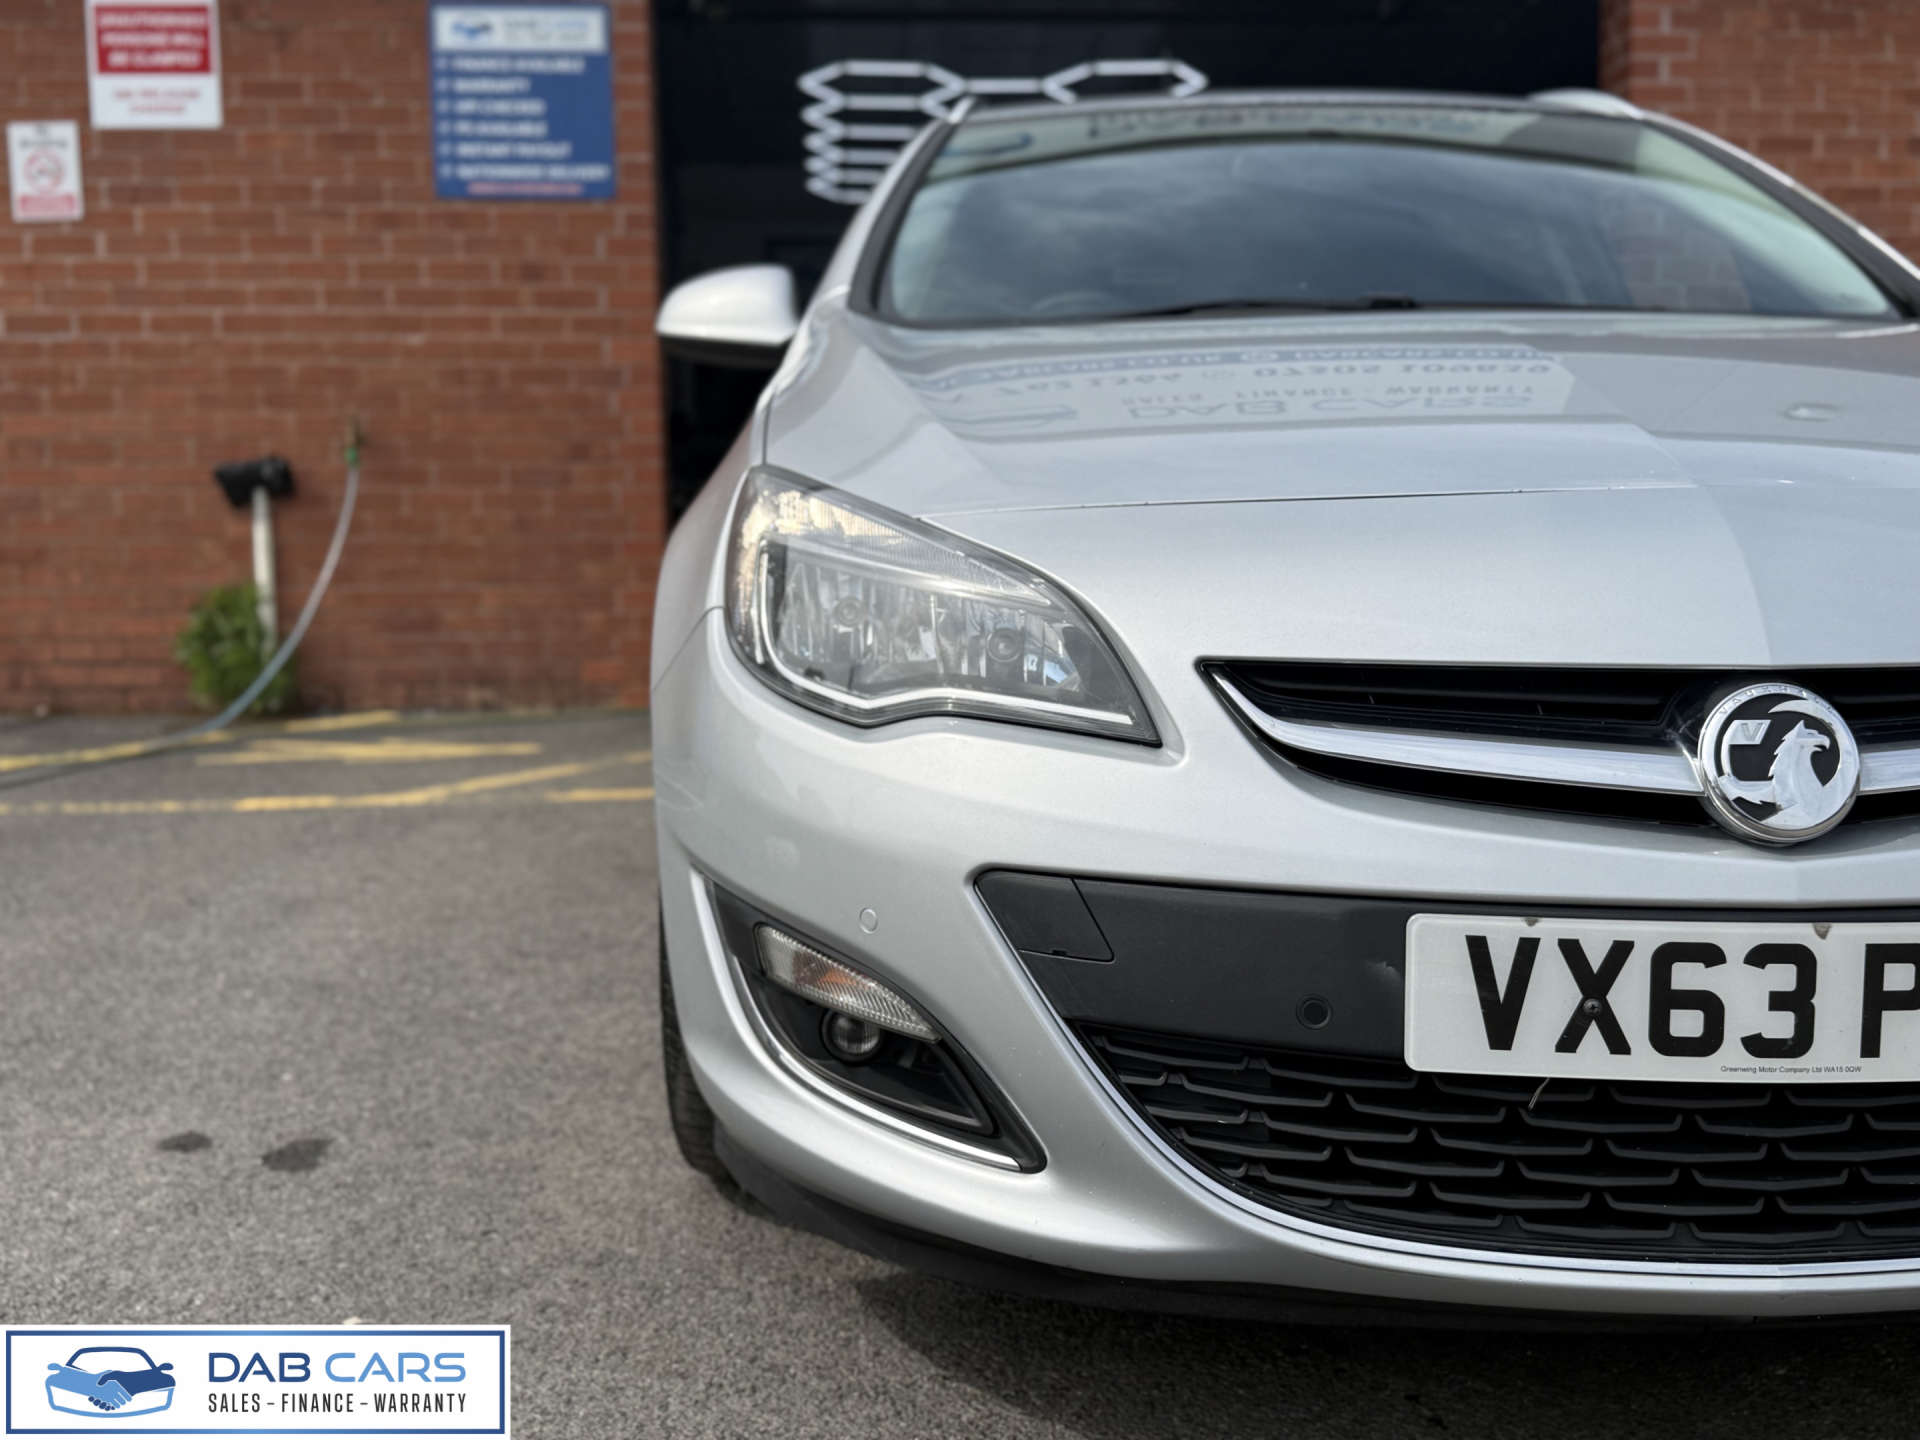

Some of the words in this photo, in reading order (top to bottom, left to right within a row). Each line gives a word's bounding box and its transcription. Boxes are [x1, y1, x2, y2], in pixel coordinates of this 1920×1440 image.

[1465, 934, 1818, 1059] VX63
[1720, 1065, 1757, 1074] Greenwing
[1758, 1065, 1778, 1073] Motor
[1778, 1065, 1810, 1074] Company
